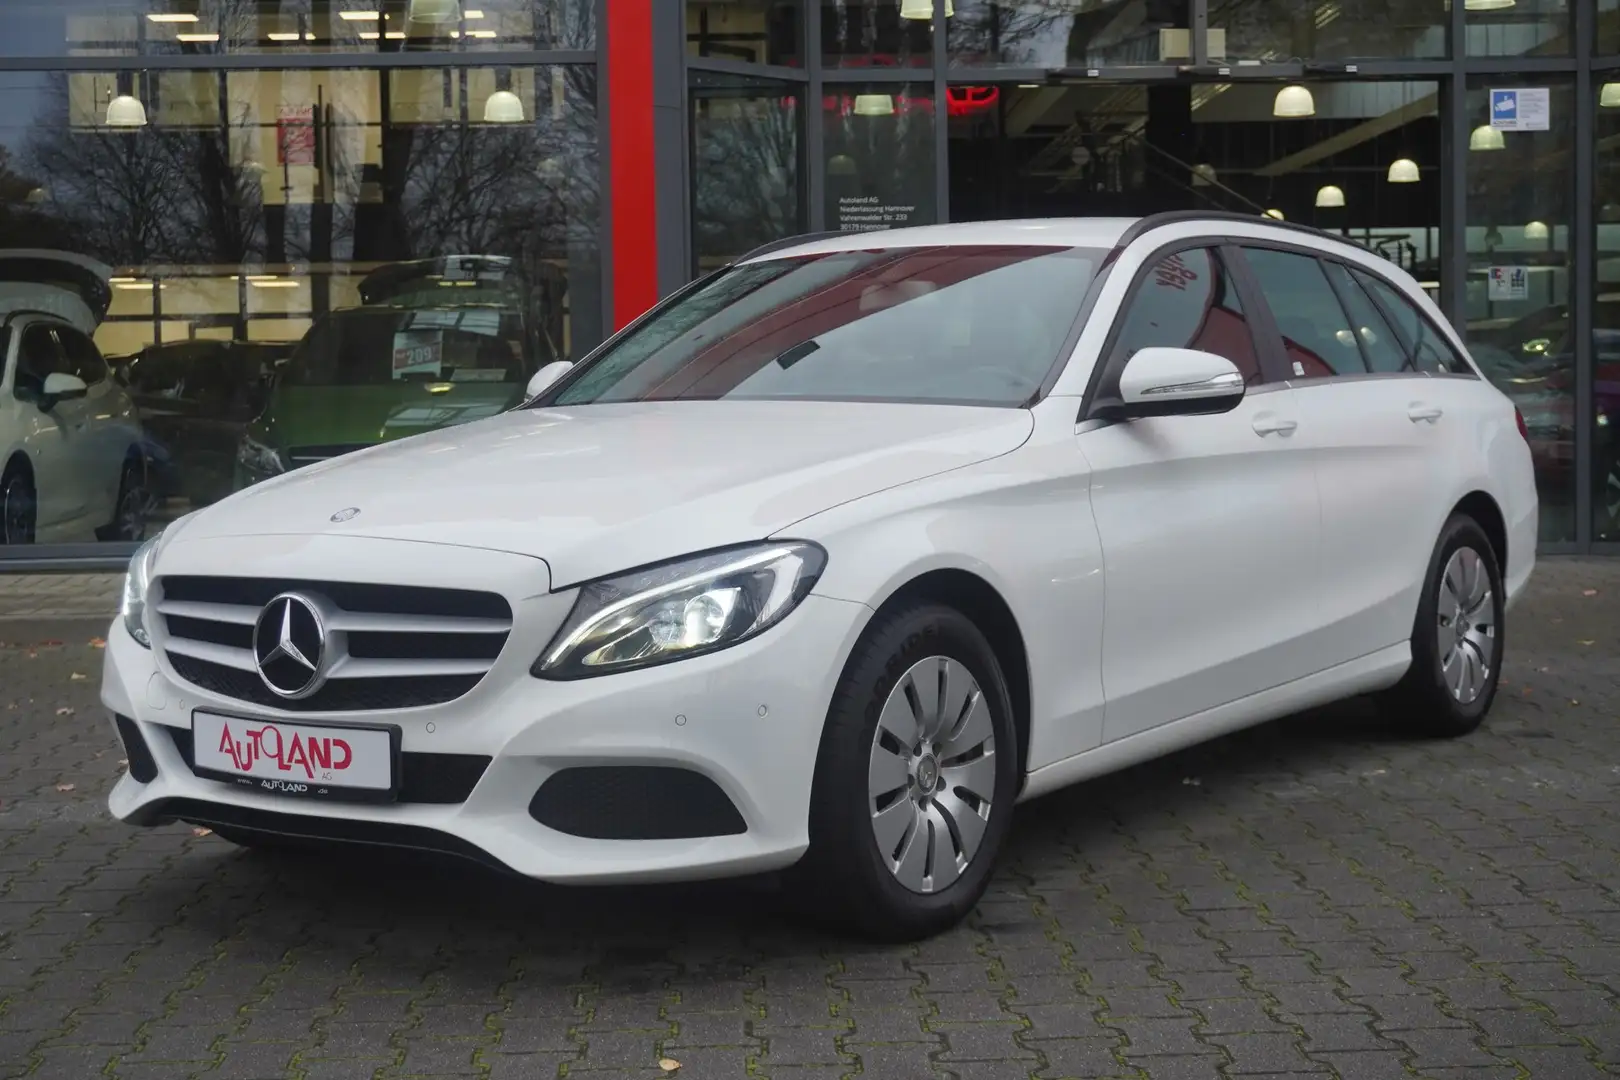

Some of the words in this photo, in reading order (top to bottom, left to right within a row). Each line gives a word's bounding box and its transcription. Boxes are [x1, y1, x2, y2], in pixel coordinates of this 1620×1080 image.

[840, 205, 884, 214] Niederlassung
[860, 223, 891, 231] Hannover
[218, 721, 353, 779] AUTOLAND
[321, 772, 333, 781] AG
[261, 779, 308, 792] AUTOLAND
